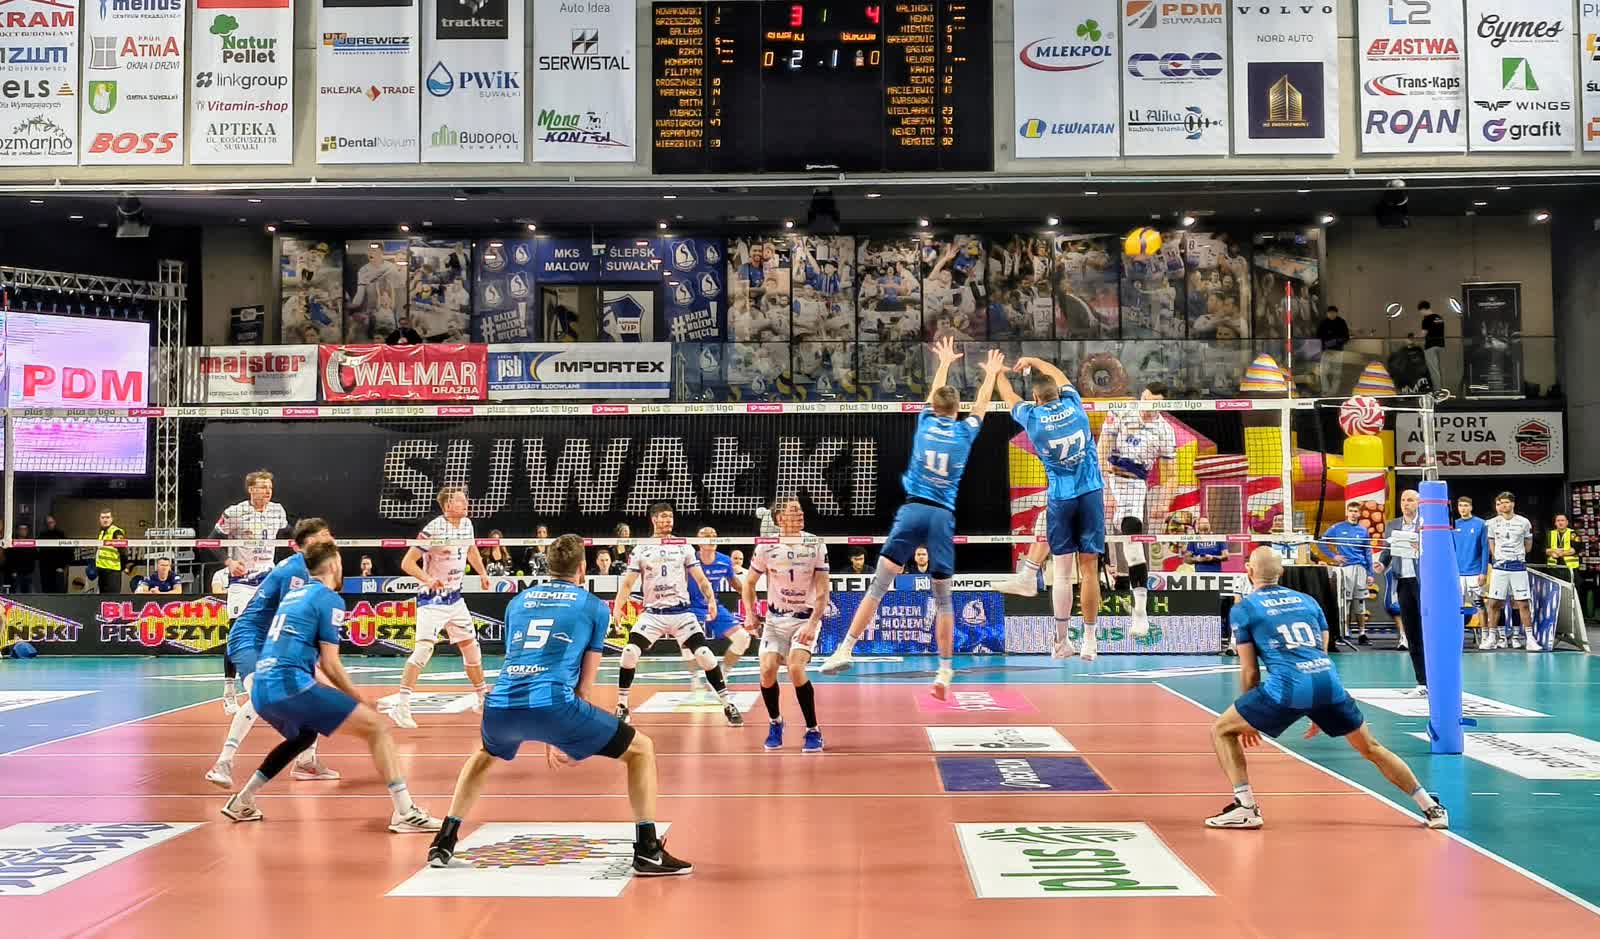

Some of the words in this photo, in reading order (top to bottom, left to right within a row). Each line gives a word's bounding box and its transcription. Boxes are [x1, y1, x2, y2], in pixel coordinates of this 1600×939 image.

[560, 3, 581, 13] Auto
[588, 3, 610, 13] Idea
[1162, 3, 1222, 16] PDM
[1238, 6, 1333, 14] VOLVO
[0, 12, 74, 27] RAM
[791, 6, 803, 26] 3
[866, 6, 880, 23] 4
[441, 18, 504, 27] tracktec
[222, 36, 277, 50] Natur
[1257, 34, 1282, 43] NORD
[1288, 34, 1314, 42] AUTO
[120, 36, 180, 57] ATMA
[1036, 45, 1112, 57] MLEKPOL
[1390, 39, 1459, 54] ASTWA
[222, 50, 275, 64] Pellet
[764, 51, 774, 66] 0
[791, 49, 803, 67] 2
[870, 51, 880, 65] 0
[539, 57, 630, 70] SERWISTAL
[217, 74, 288, 90] linkgroup
[460, 71, 520, 89] PWiK
[1396, 77, 1460, 89] Trans-Kaps
[320, 86, 362, 94] SKLEJKA
[382, 86, 416, 94] TRADE
[207, 101, 288, 112] Vitamin-shop
[1516, 102, 1571, 111] WINGS
[207, 123, 276, 136] APTEKA
[1052, 123, 1114, 134] LEWIATAN
[1365, 109, 1461, 143] ROAN
[1510, 121, 1561, 140] grafit
[460, 131, 518, 143] BUDOPOL
[89, 133, 177, 154] BOSS
[554, 248, 580, 258] MKS
[610, 246, 655, 258] ŚLEPSK
[545, 262, 589, 271] MALOW
[621, 324, 637, 332] VIP
[200, 351, 306, 384] majster
[554, 361, 665, 373] IMPORTEX
[355, 362, 477, 387] WALMAR
[24, 365, 143, 402] PDM
[375, 406, 394, 415] plus
[487, 406, 506, 414] plus
[530, 405, 549, 414] plus
[641, 404, 660, 413] plus
[685, 404, 704, 413] plus
[796, 403, 815, 412] plus
[840, 403, 859, 412] plus
[1108, 401, 1127, 409] plus
[1152, 400, 1171, 409] plus
[24, 408, 43, 417] plus
[67, 408, 86, 417] plus
[177, 407, 196, 416] plus
[220, 408, 239, 417] plus
[332, 407, 351, 416] plus
[1461, 430, 1496, 442] USA
[924, 450, 949, 476] 11
[379, 436, 878, 519] SUWAŁKI
[661, 565, 667, 576] 8
[788, 569, 794, 582] 1
[524, 591, 578, 601] NIEMIEC
[101, 601, 224, 620] BLACHY
[268, 613, 287, 642] 4
[523, 619, 554, 648] 5
[1277, 622, 1316, 649] 10
[1001, 848, 1179, 892] plus
